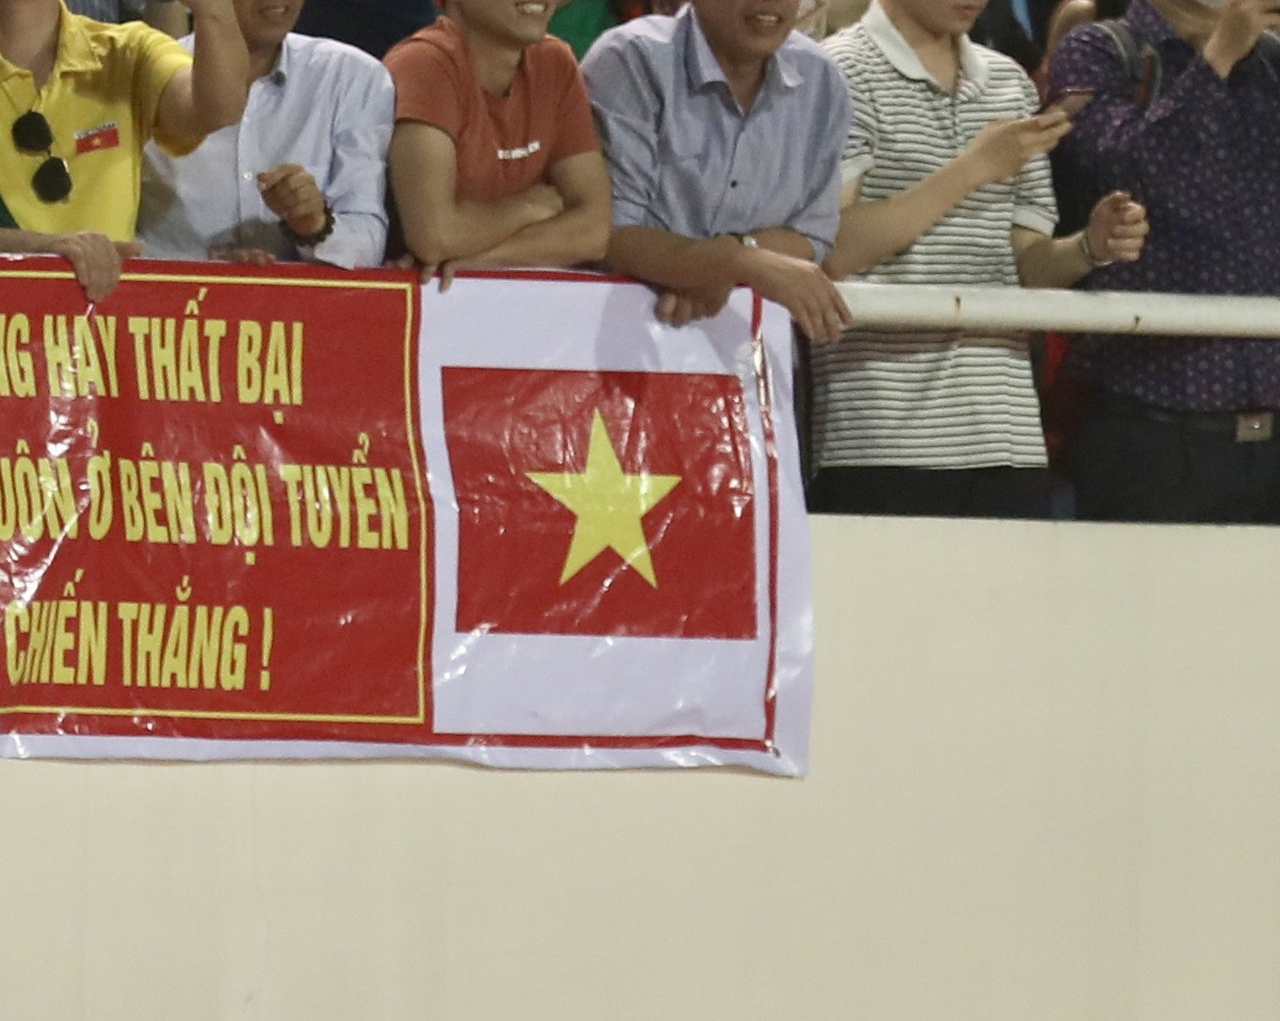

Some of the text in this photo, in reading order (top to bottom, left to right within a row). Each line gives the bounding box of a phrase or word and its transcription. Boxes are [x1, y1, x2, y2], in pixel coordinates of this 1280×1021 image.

[43, 314, 119, 398] HAY
[127, 287, 227, 403] THẤT
[236, 320, 304, 425] BẠI
[86, 417, 113, 541] Ở
[118, 442, 197, 544] BÊN
[202, 444, 274, 565] ĐỘI
[278, 432, 409, 550] TUYỂN
[4, 568, 109, 686] CHIẾN
[117, 575, 250, 691] THẮNG
